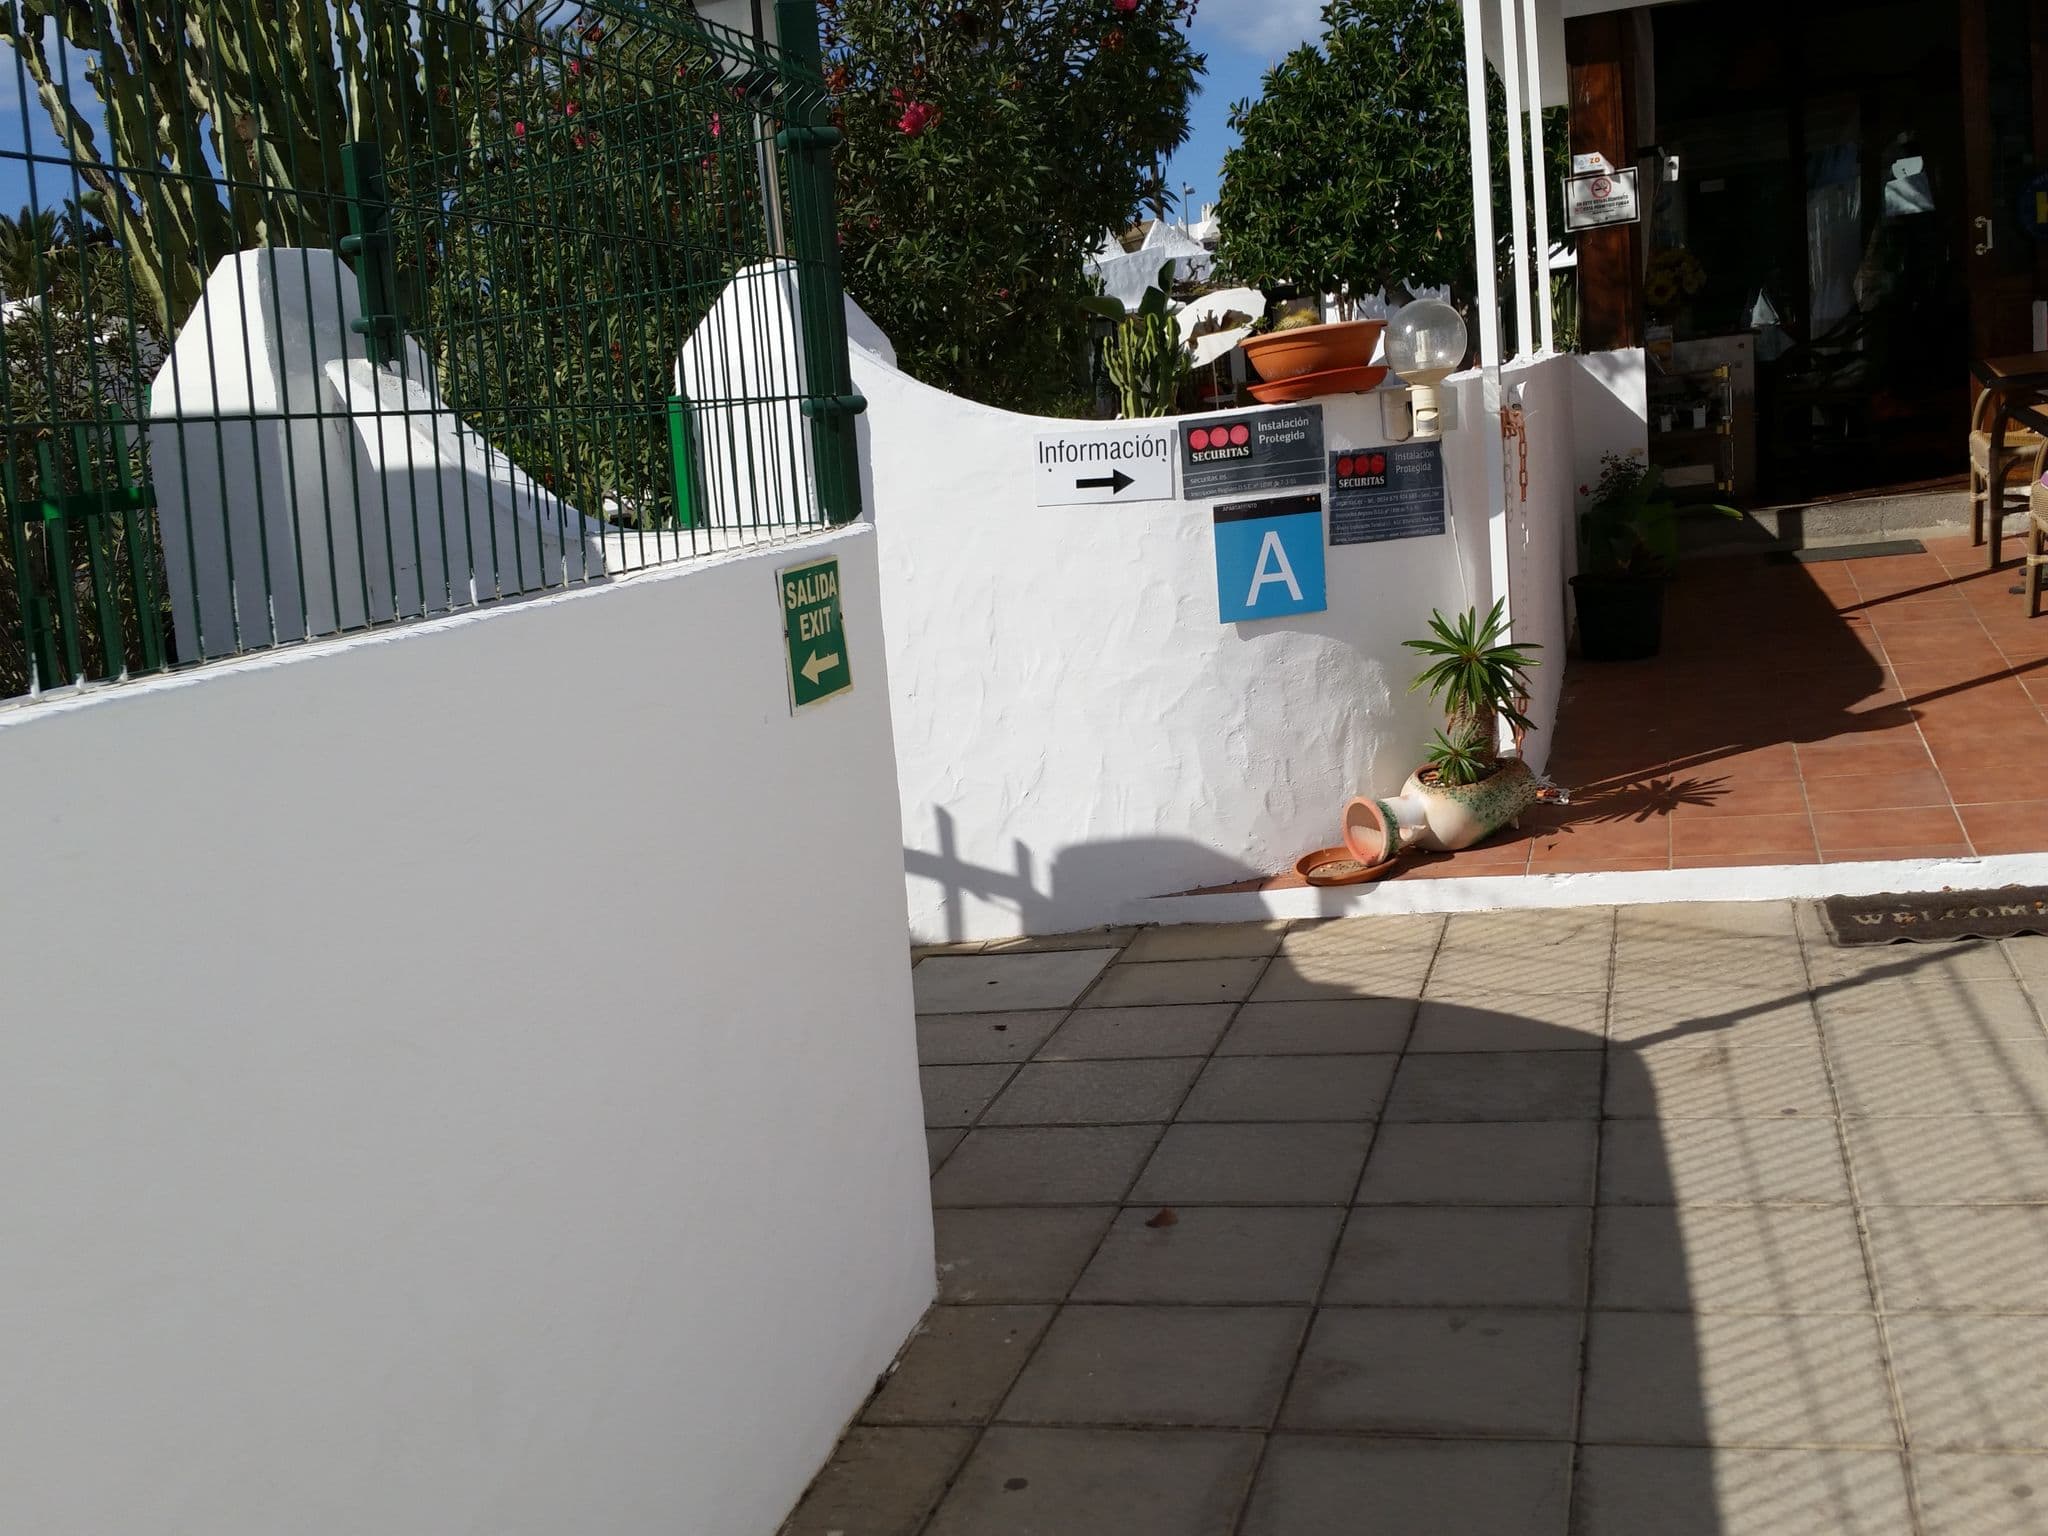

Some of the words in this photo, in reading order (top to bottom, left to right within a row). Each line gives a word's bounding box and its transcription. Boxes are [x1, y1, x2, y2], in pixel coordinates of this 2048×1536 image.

[1257, 416, 1309, 432] Instalación
[1259, 430, 1305, 445] Protegida
[1039, 433, 1168, 464] Información
[1192, 446, 1250, 463] SECURITAS
[1395, 448, 1434, 461] Instalación
[1395, 462, 1432, 474] Protegida
[1338, 475, 1385, 489] SECURITAS
[1245, 530, 1304, 607] A
[786, 570, 838, 610] SALIDA
[800, 605, 832, 642] EXIT
